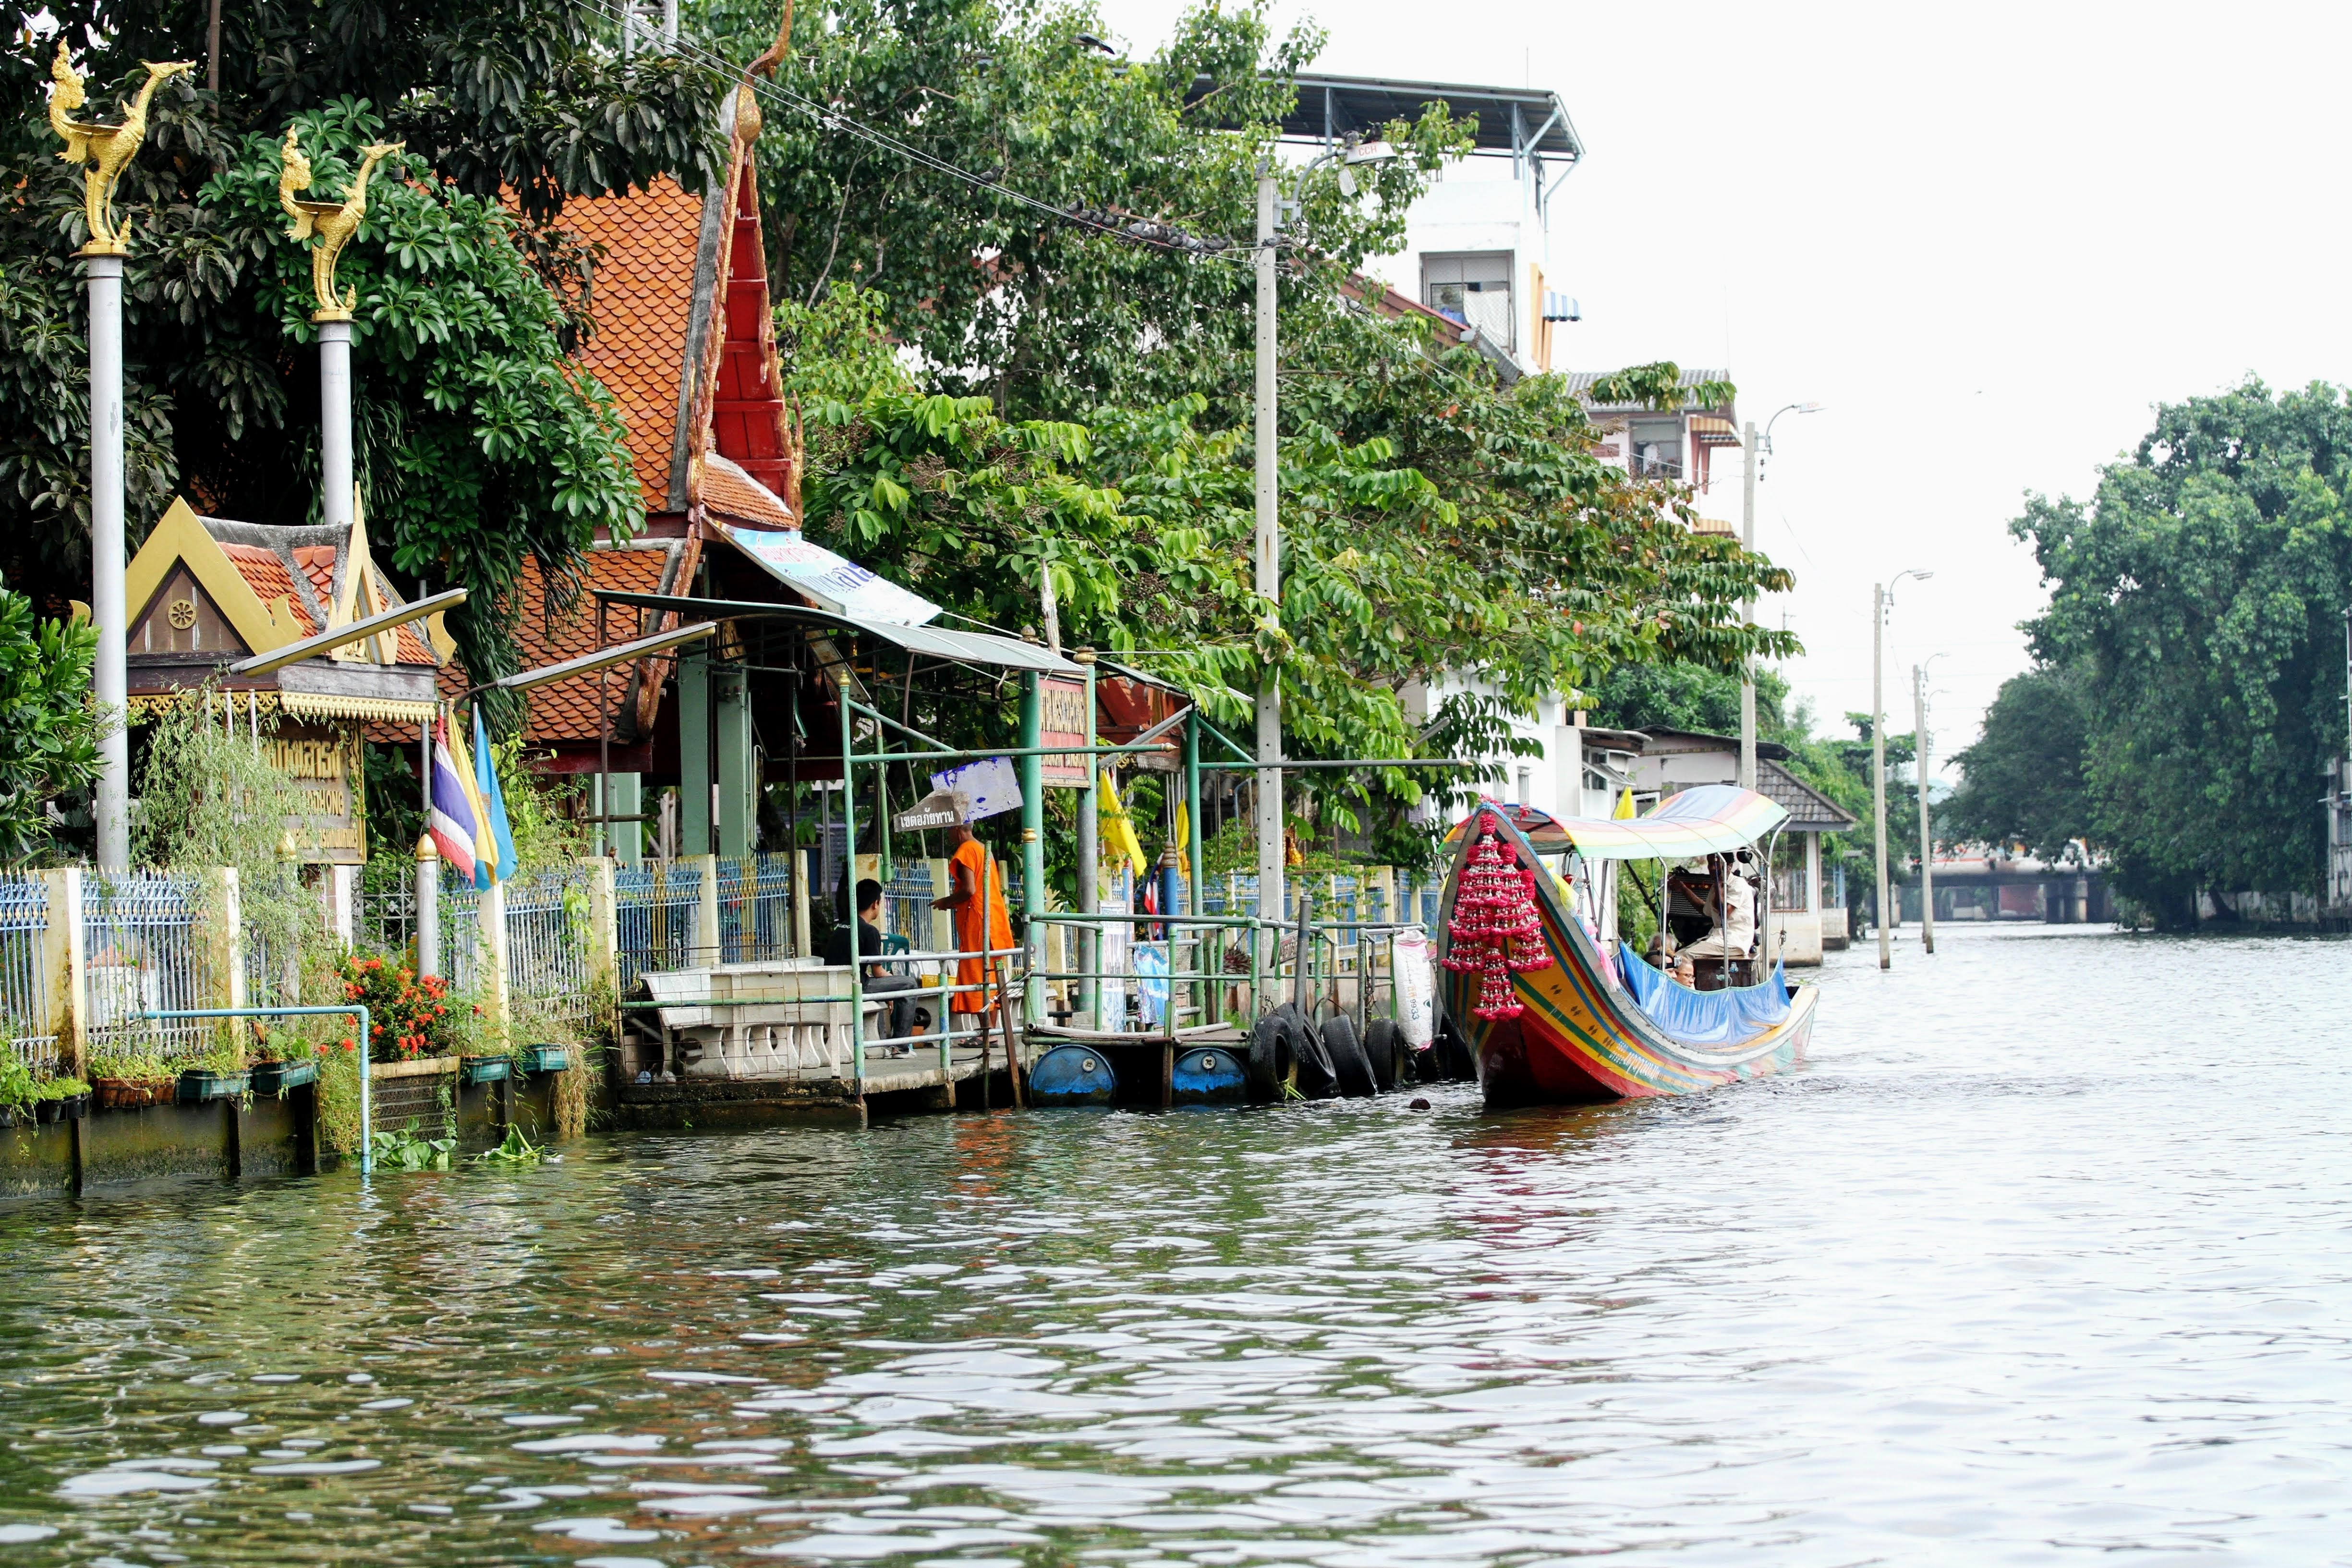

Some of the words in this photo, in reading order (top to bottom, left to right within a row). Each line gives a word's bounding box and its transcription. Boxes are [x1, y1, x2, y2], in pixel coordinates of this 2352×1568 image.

[1359, 146, 1377, 156] CCH
[900, 807, 955, 827] เขตอภัยทาน
[1410, 999, 1419, 1020] 9933
